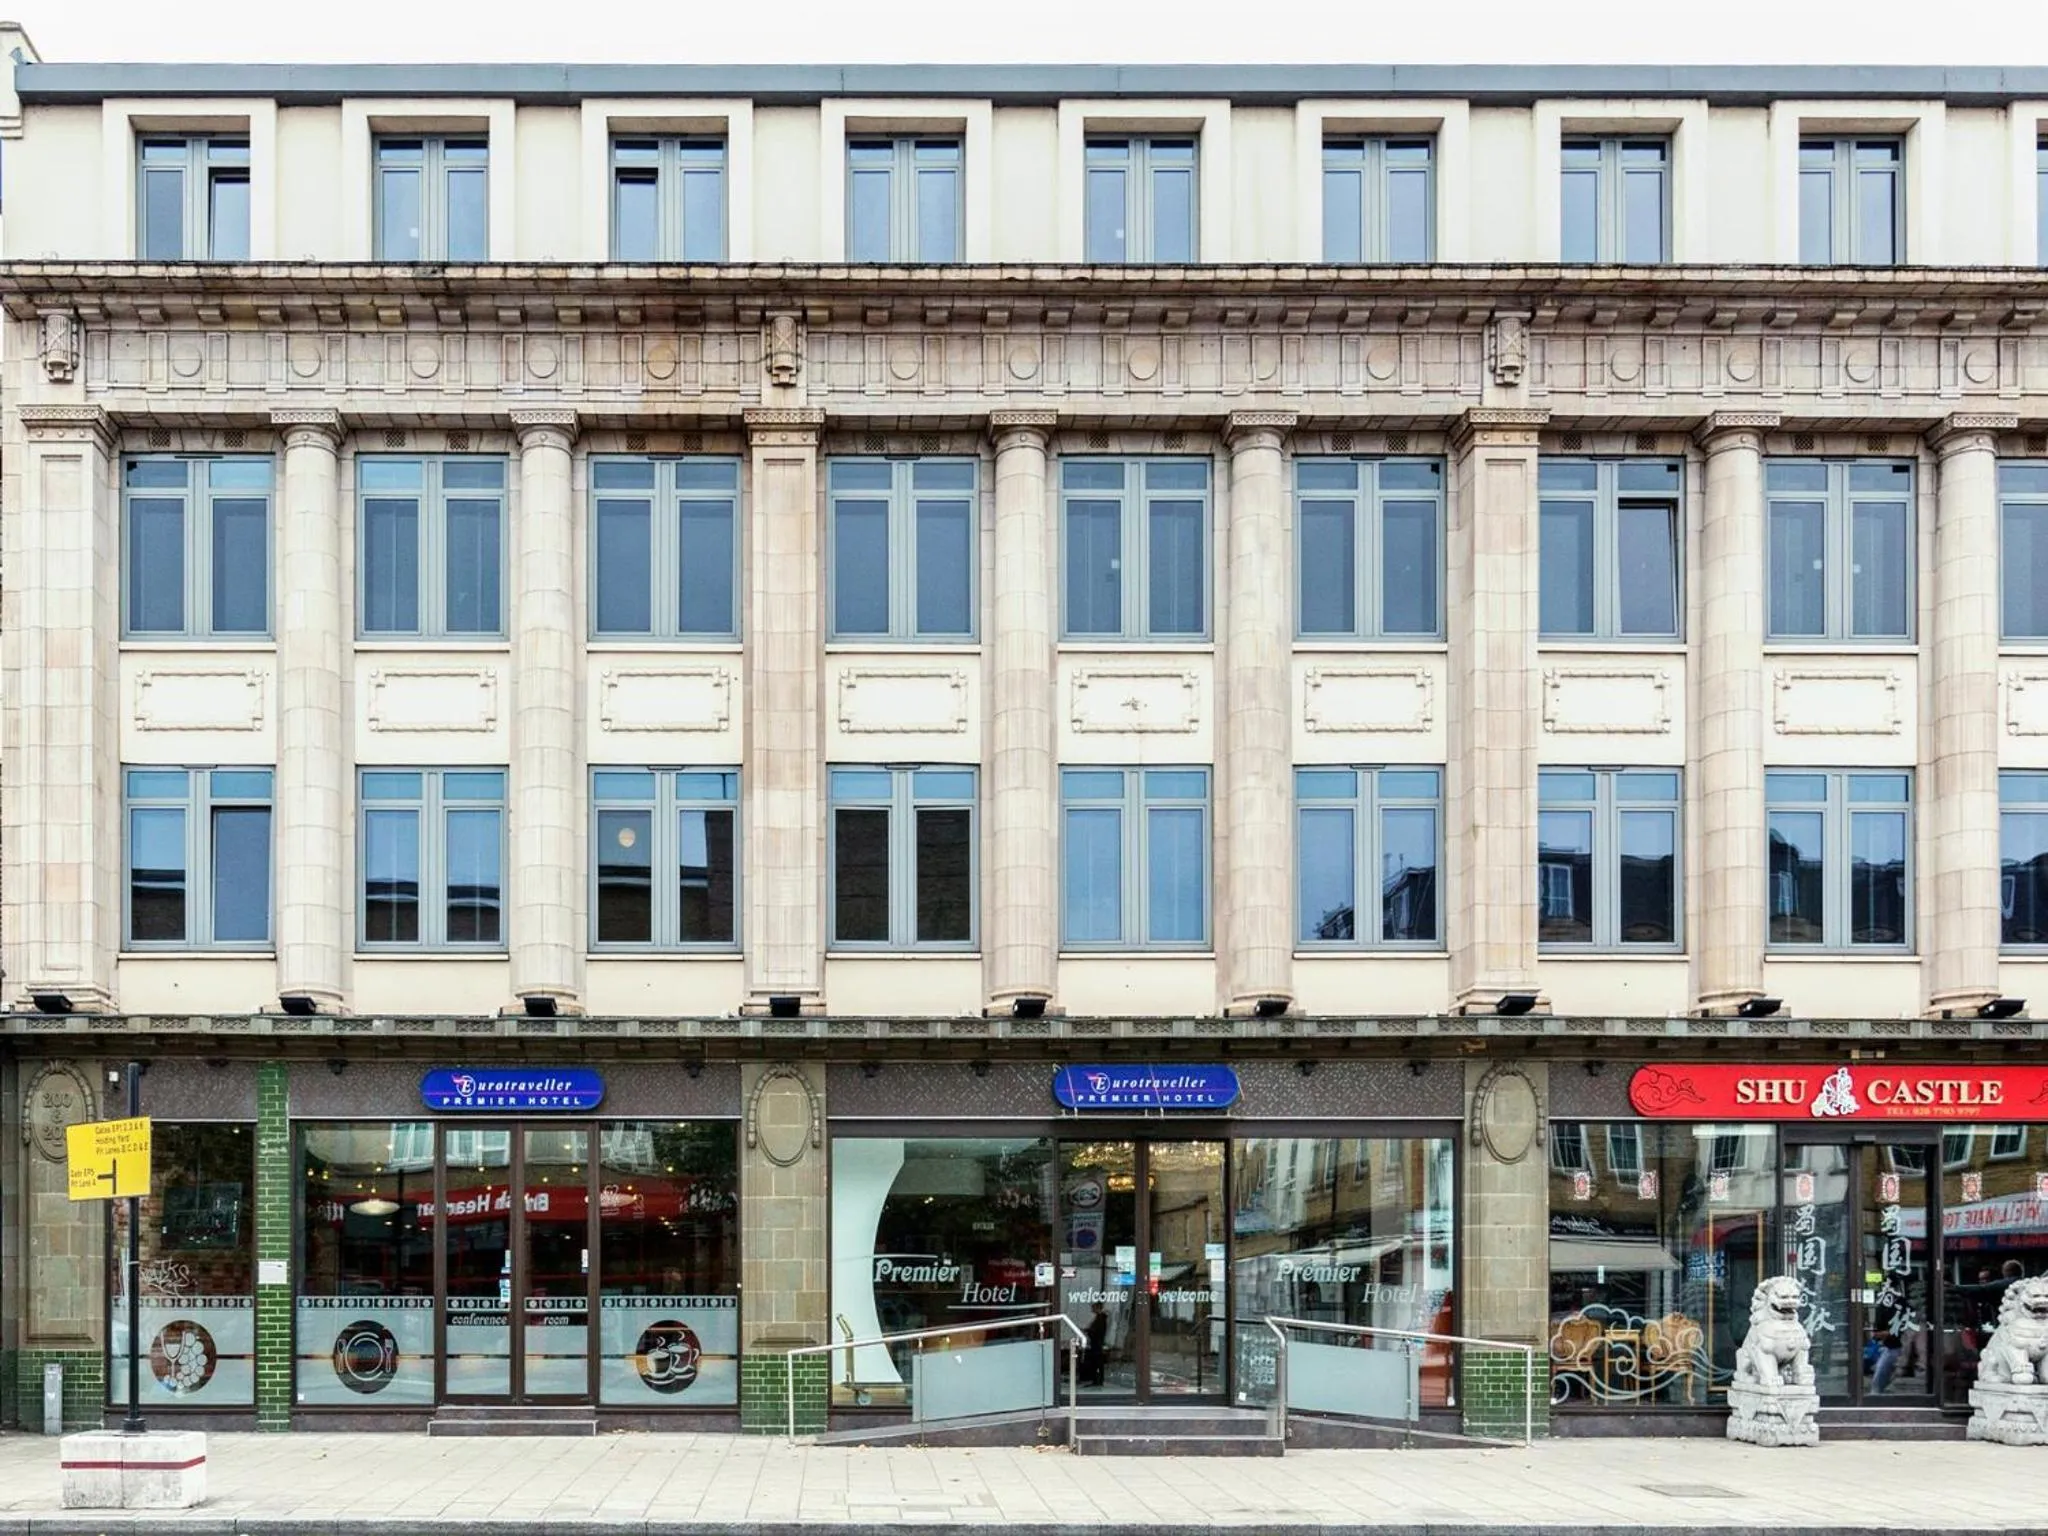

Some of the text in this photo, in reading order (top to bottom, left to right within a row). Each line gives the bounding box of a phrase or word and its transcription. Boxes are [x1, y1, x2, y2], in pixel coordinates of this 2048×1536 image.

[459, 1075, 573, 1095] Eurotraveller
[1093, 1075, 1207, 1093] Eurotraveller
[1736, 1079, 2004, 1105] SHU CASTLE
[443, 1097, 581, 1105] PREMIER HOTEL
[1077, 1094, 1215, 1103] PREMIER HOTEL
[874, 1258, 961, 1283] Premier
[1275, 1258, 1361, 1283] Premier
[961, 1281, 1017, 1303] Hotel
[1067, 1286, 1129, 1303] welcome
[1157, 1286, 1219, 1303] welcome
[1362, 1282, 1418, 1304] Hotel
[451, 1312, 569, 1326] conference room
